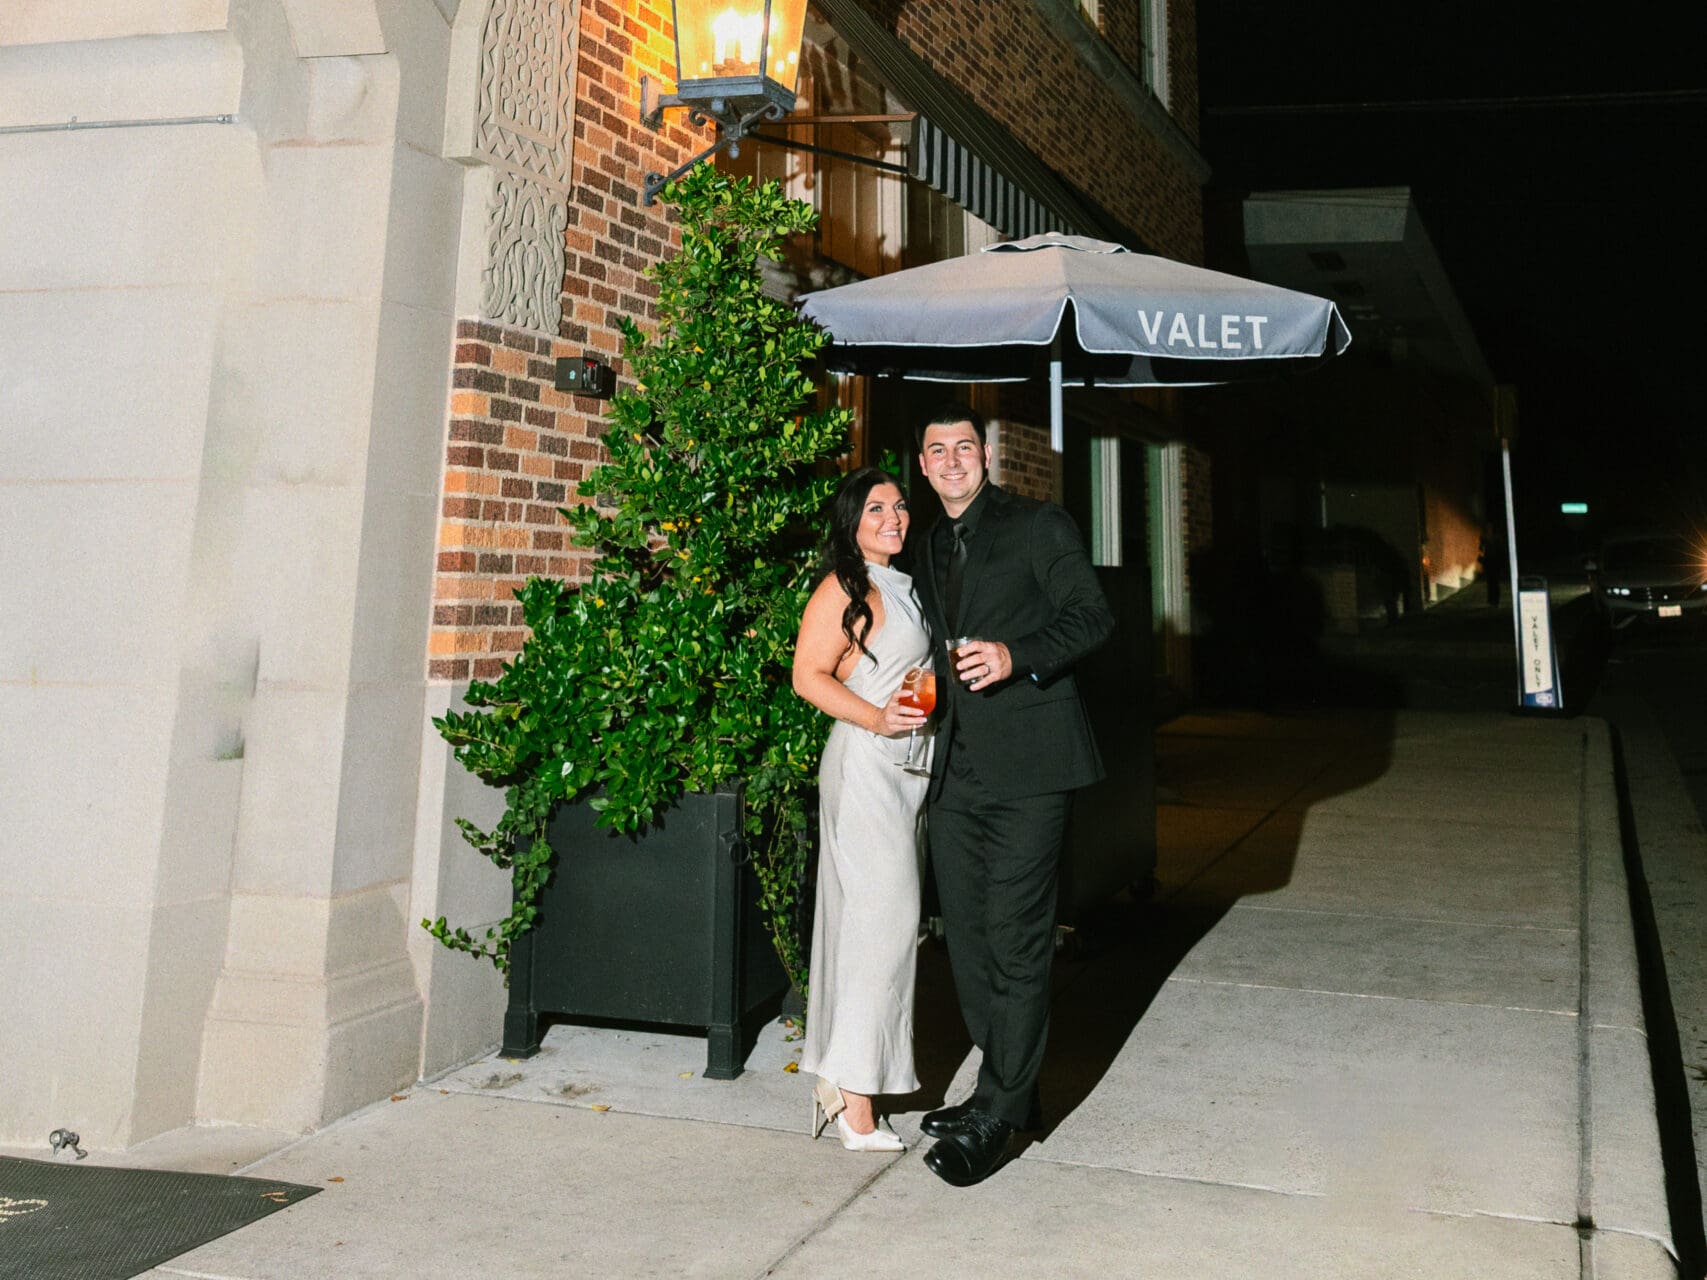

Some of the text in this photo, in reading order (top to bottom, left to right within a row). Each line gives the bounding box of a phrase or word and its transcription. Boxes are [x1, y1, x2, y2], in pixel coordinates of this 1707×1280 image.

[1138, 310, 1268, 349] VALET
[1531, 615, 1541, 688] VALET ONLY
